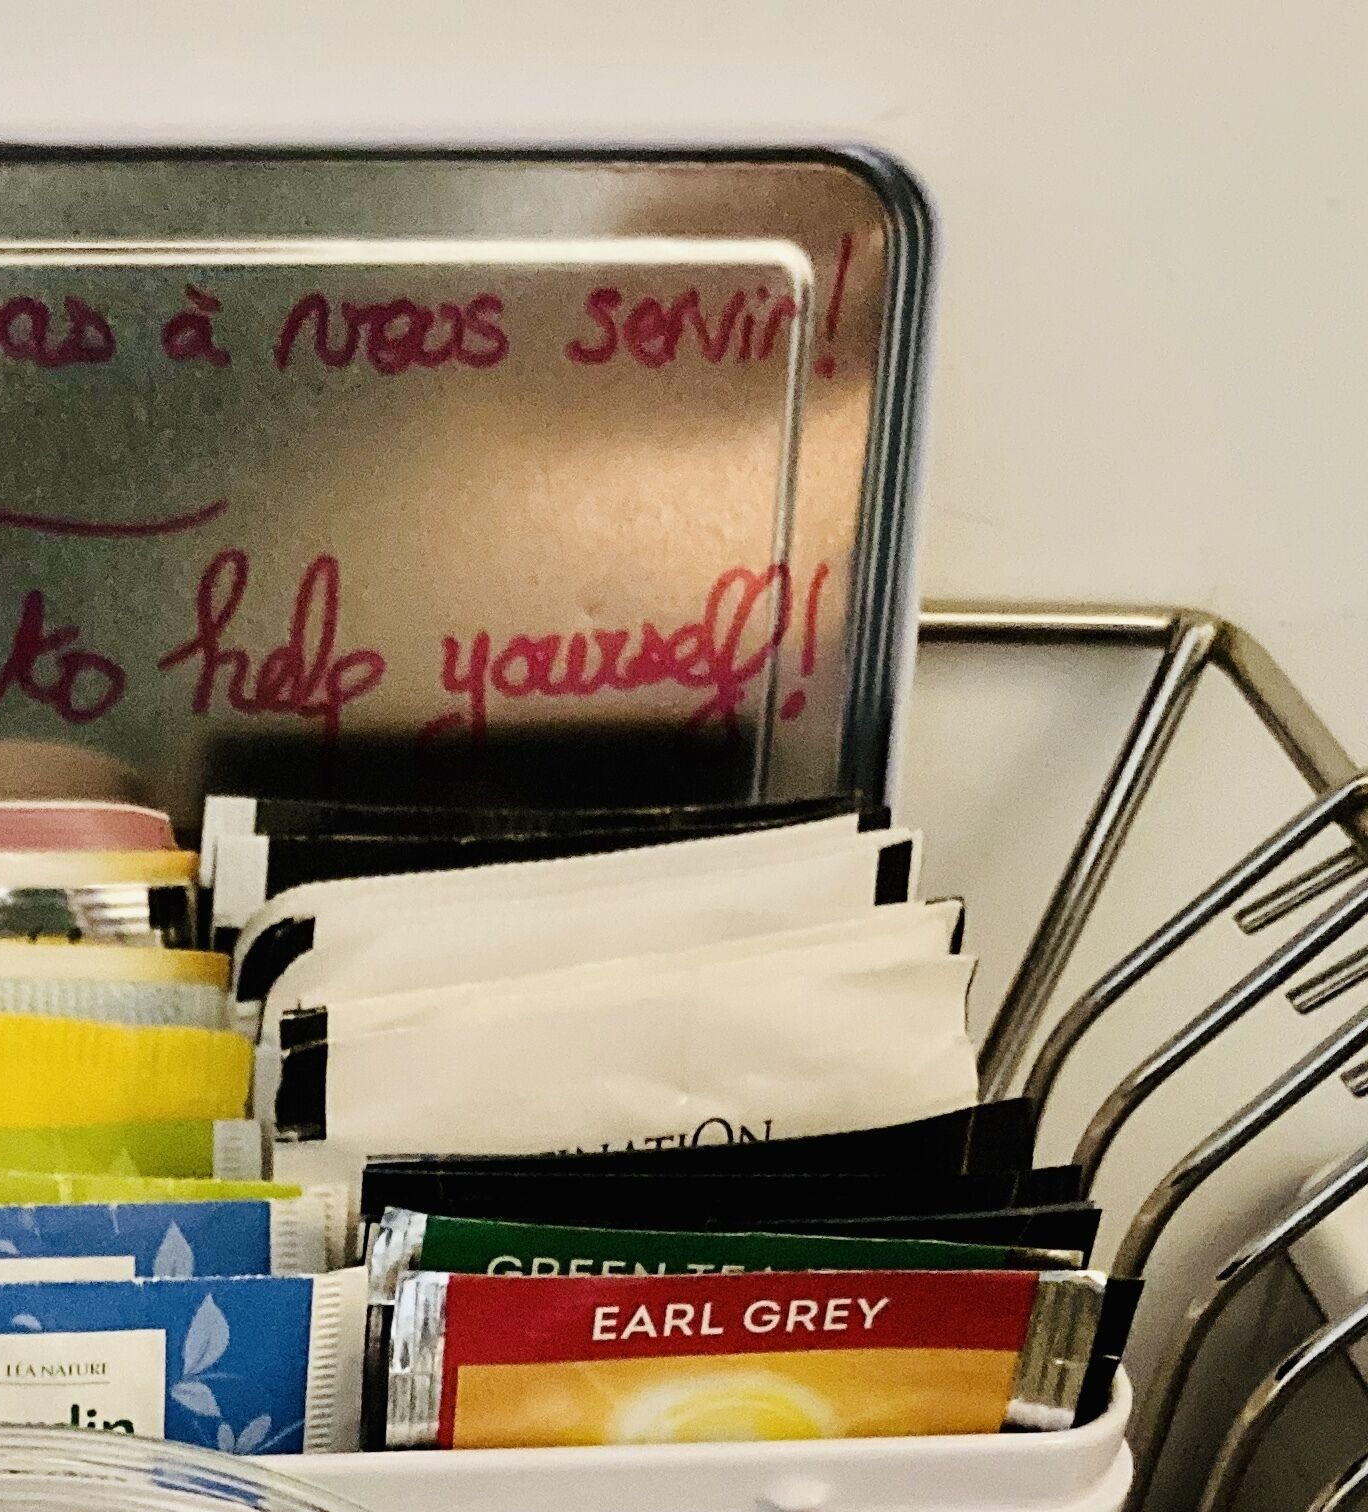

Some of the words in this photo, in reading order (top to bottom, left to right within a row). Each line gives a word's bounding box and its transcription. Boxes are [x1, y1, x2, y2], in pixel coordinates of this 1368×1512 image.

[160, 283, 230, 366] à
[274, 291, 510, 376] vous
[157, 549, 386, 748] help
[416, 562, 831, 750] yourself!
[591, 1302, 724, 1341] EARL
[743, 1297, 890, 1334] GREY
[6, 1361, 36, 1378] LÉA
[41, 1362, 108, 1378] NATURE
